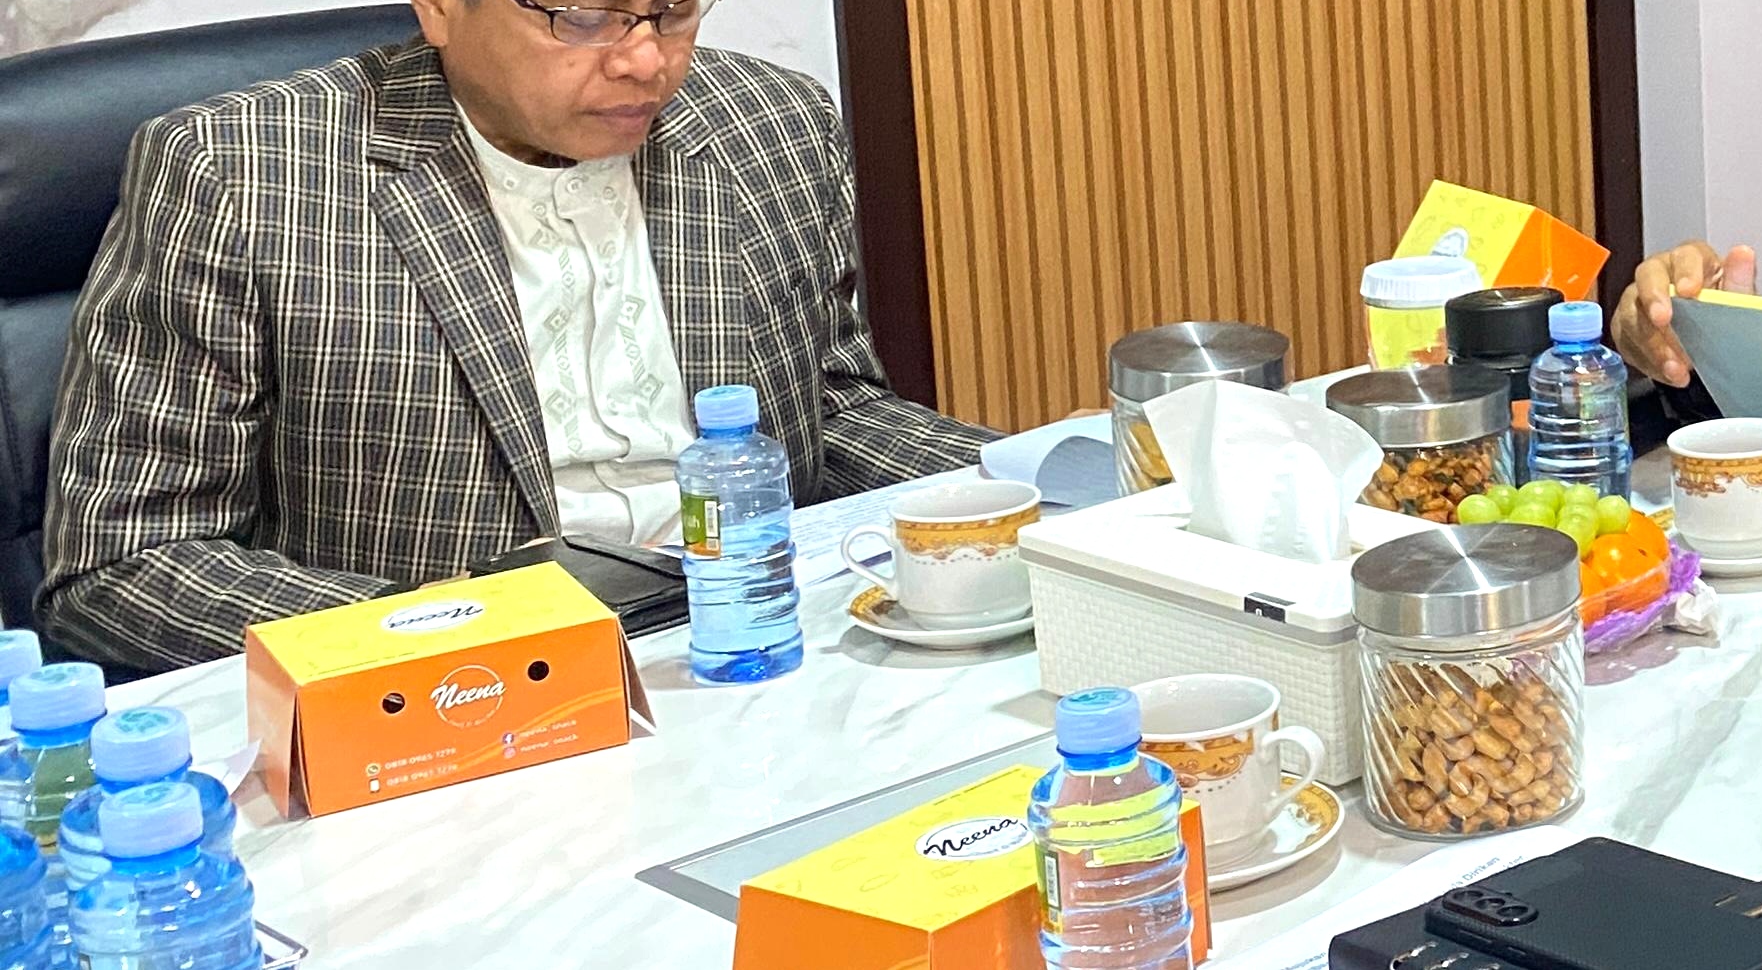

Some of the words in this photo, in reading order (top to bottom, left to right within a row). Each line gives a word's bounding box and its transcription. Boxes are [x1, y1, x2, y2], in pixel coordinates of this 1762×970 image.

[389, 606, 483, 628] Neena
[430, 681, 507, 710] Neena
[923, 819, 1018, 856] Neena
